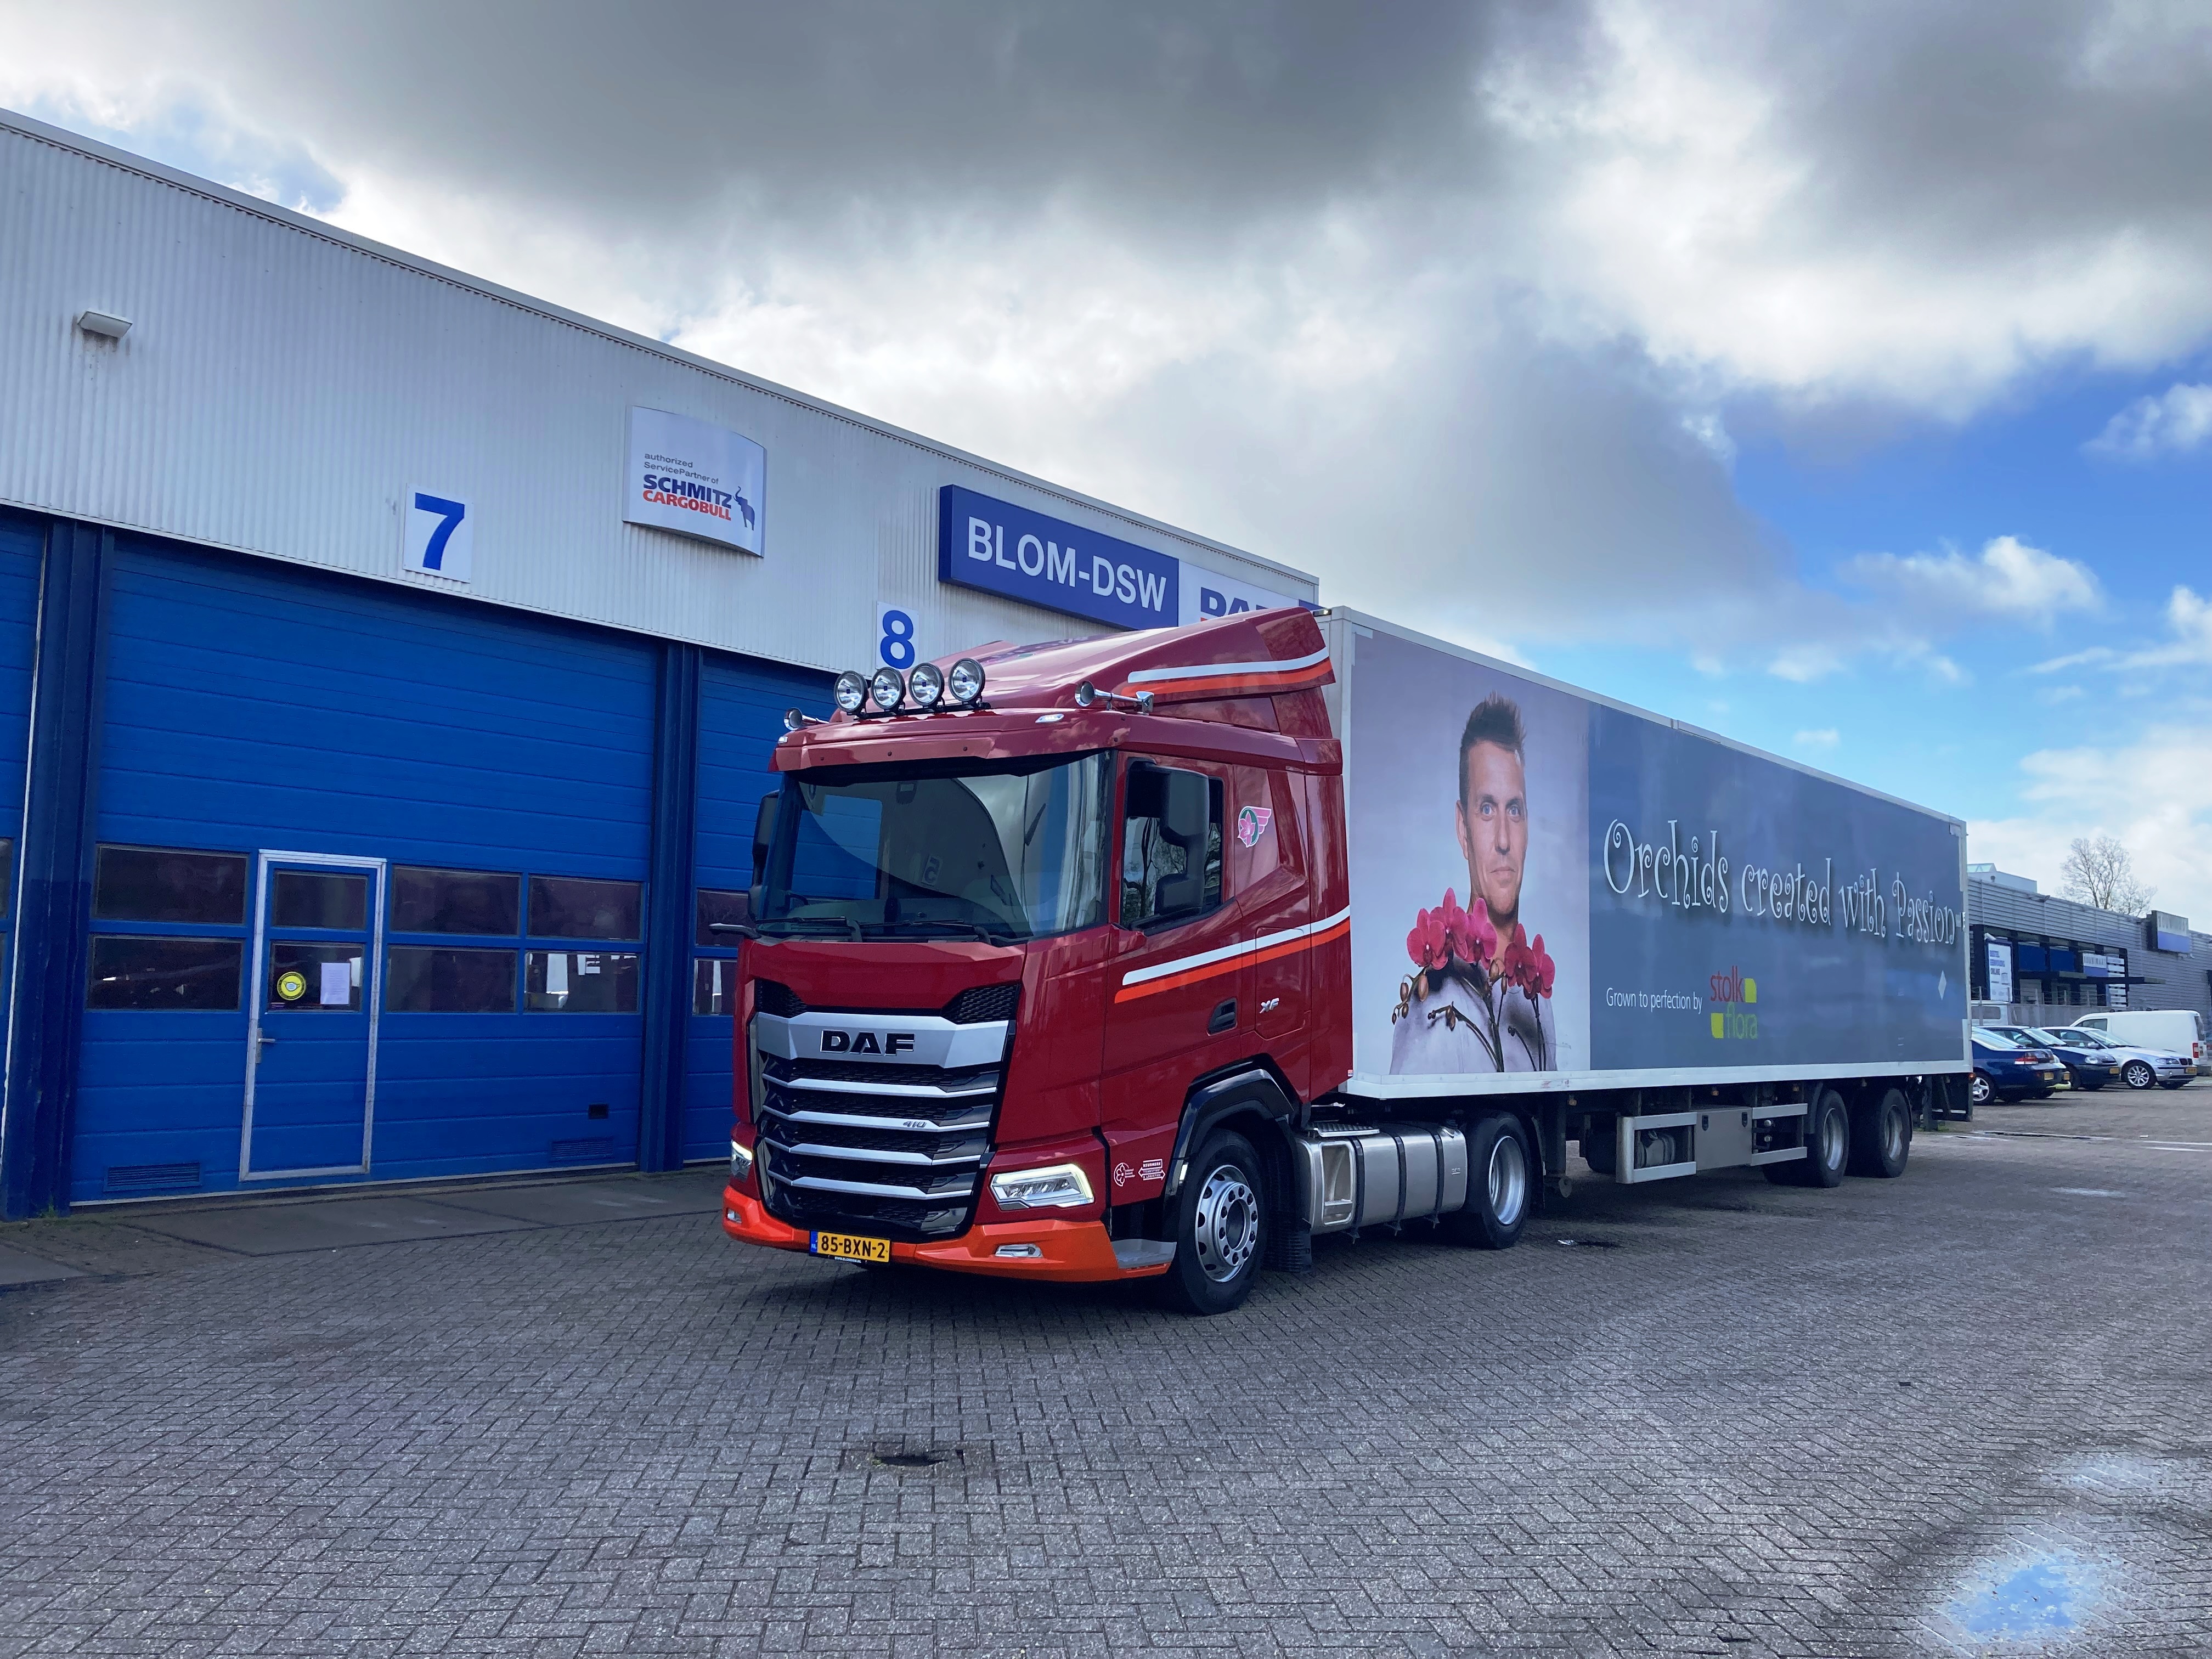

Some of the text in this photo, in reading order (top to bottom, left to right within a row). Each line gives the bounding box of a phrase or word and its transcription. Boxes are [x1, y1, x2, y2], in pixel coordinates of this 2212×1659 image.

[644, 453, 693, 468] authorized
[644, 461, 710, 482] ServicePartner
[643, 474, 732, 510] SCHMITZ
[643, 490, 731, 521] CARGOBULL
[415, 492, 465, 571] 7
[968, 516, 1167, 612] BLOM-DSW
[1200, 586, 1269, 618] DA
[880, 610, 915, 669] 8
[1603, 819, 1955, 945] Orchids created with Passion
[1709, 965, 1745, 1002] stolk
[1259, 997, 1279, 1014] XF
[1606, 988, 1703, 1015] Grown to perfection by
[1725, 1001, 1758, 1040] flora
[820, 1029, 916, 1057] DAF
[821, 1235, 885, 1259] 85-BXN-2
